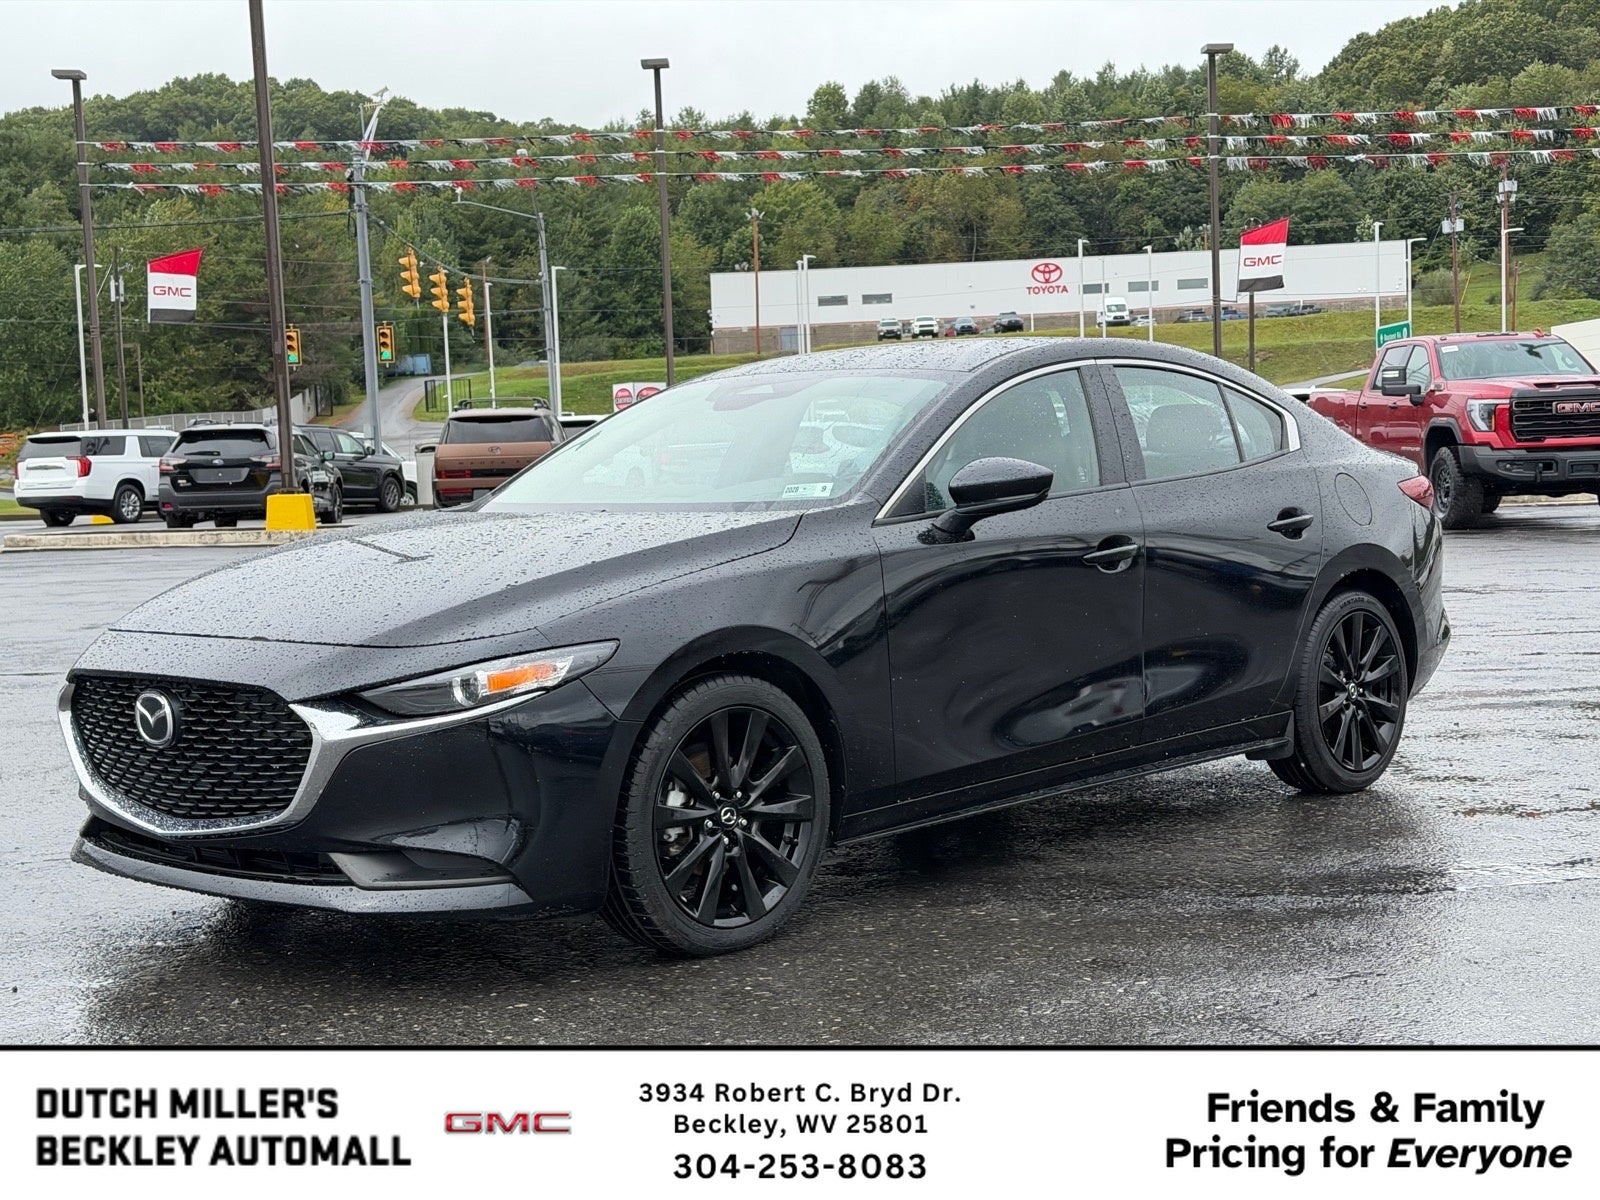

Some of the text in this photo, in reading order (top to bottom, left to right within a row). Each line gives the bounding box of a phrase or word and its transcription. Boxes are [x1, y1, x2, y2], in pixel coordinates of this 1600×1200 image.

[1243, 254, 1282, 267] GMC
[153, 285, 192, 298] GMC
[1026, 285, 1069, 295] TOYOTA
